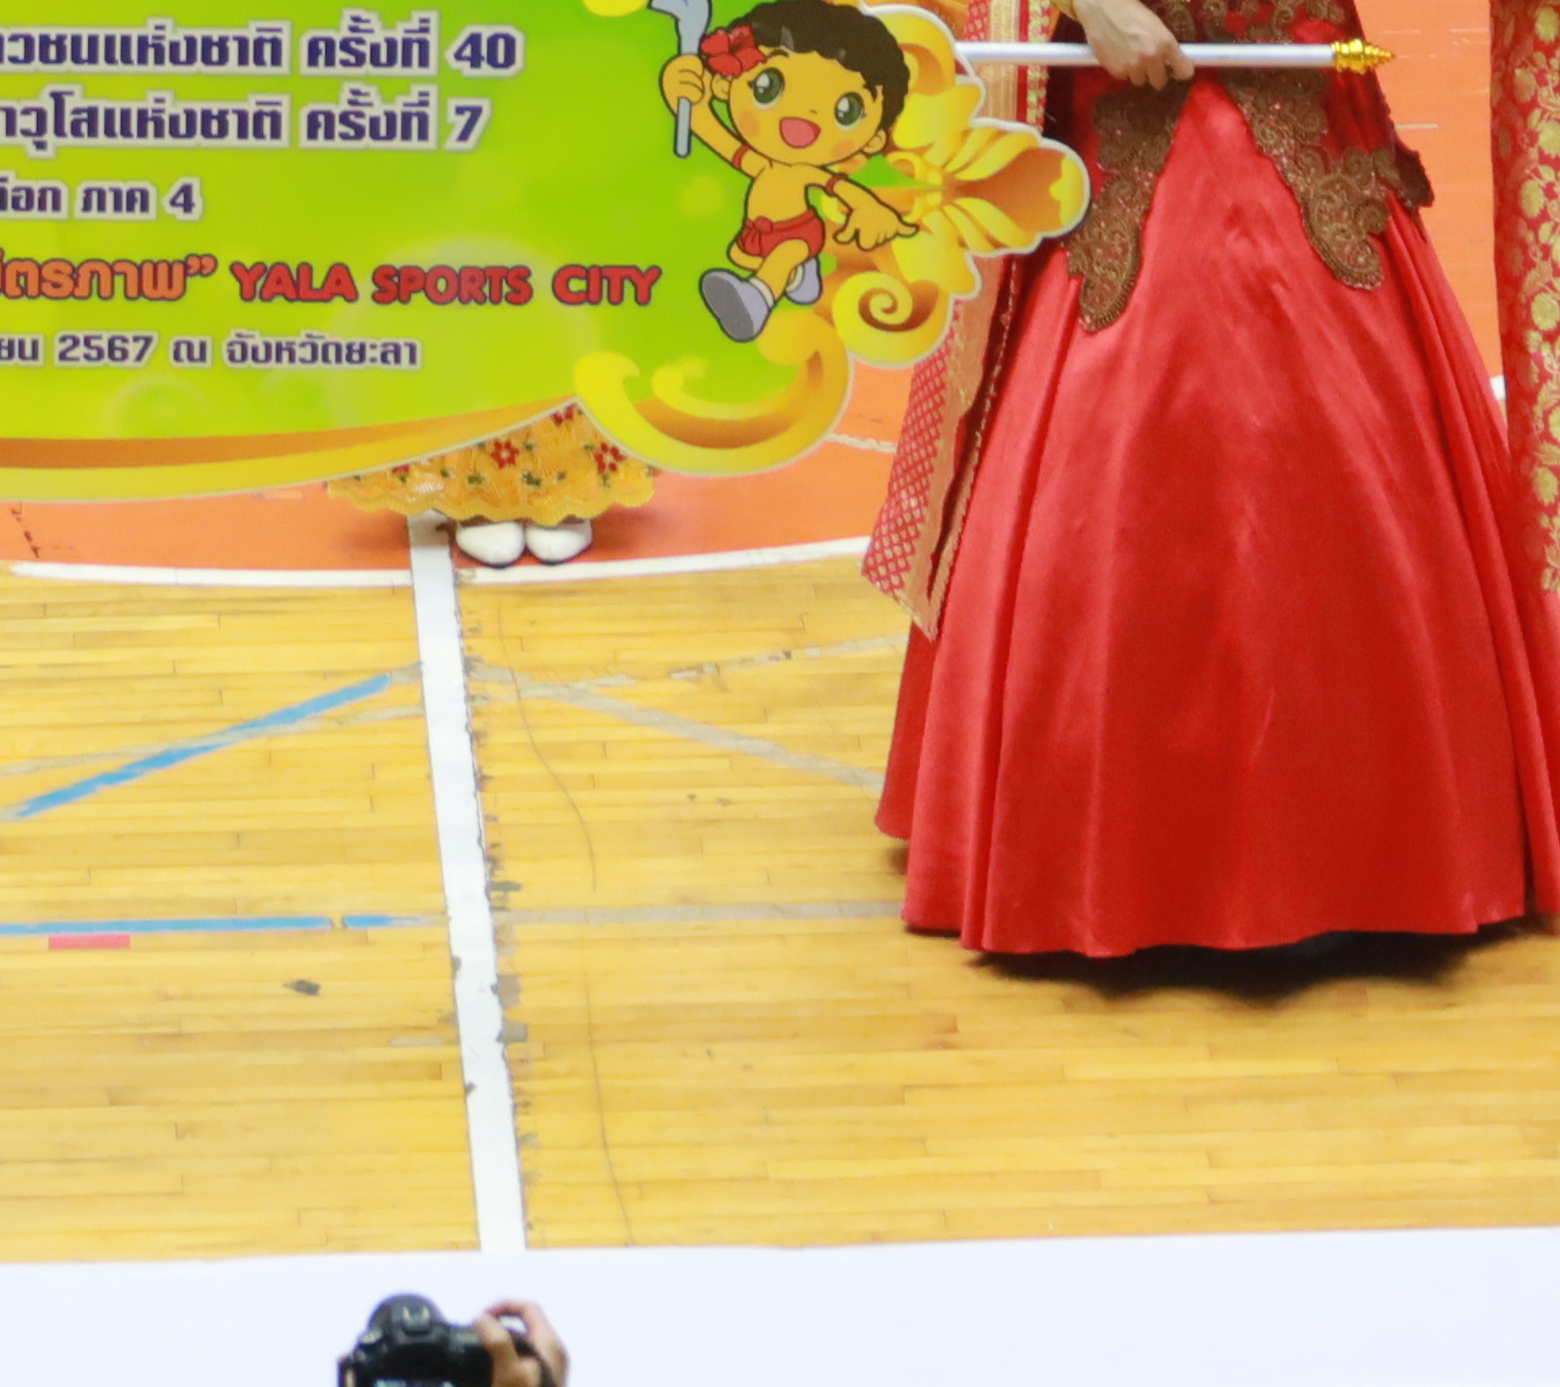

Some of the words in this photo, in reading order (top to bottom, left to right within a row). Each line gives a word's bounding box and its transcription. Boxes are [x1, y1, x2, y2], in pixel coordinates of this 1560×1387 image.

[307, 12, 430, 69] ครั้งที่
[453, 32, 516, 70] 40
[306, 88, 430, 142] ครั้งที่
[455, 106, 483, 142] 7
[81, 187, 150, 214] ภาค
[169, 183, 195, 214] 4
[230, 261, 360, 303] YALA
[371, 264, 534, 306] SPORTS
[551, 264, 662, 306] CITY
[59, 334, 152, 362] 2567
[173, 340, 207, 363] ณ
[226, 330, 417, 365] จังหวัดยะลา
